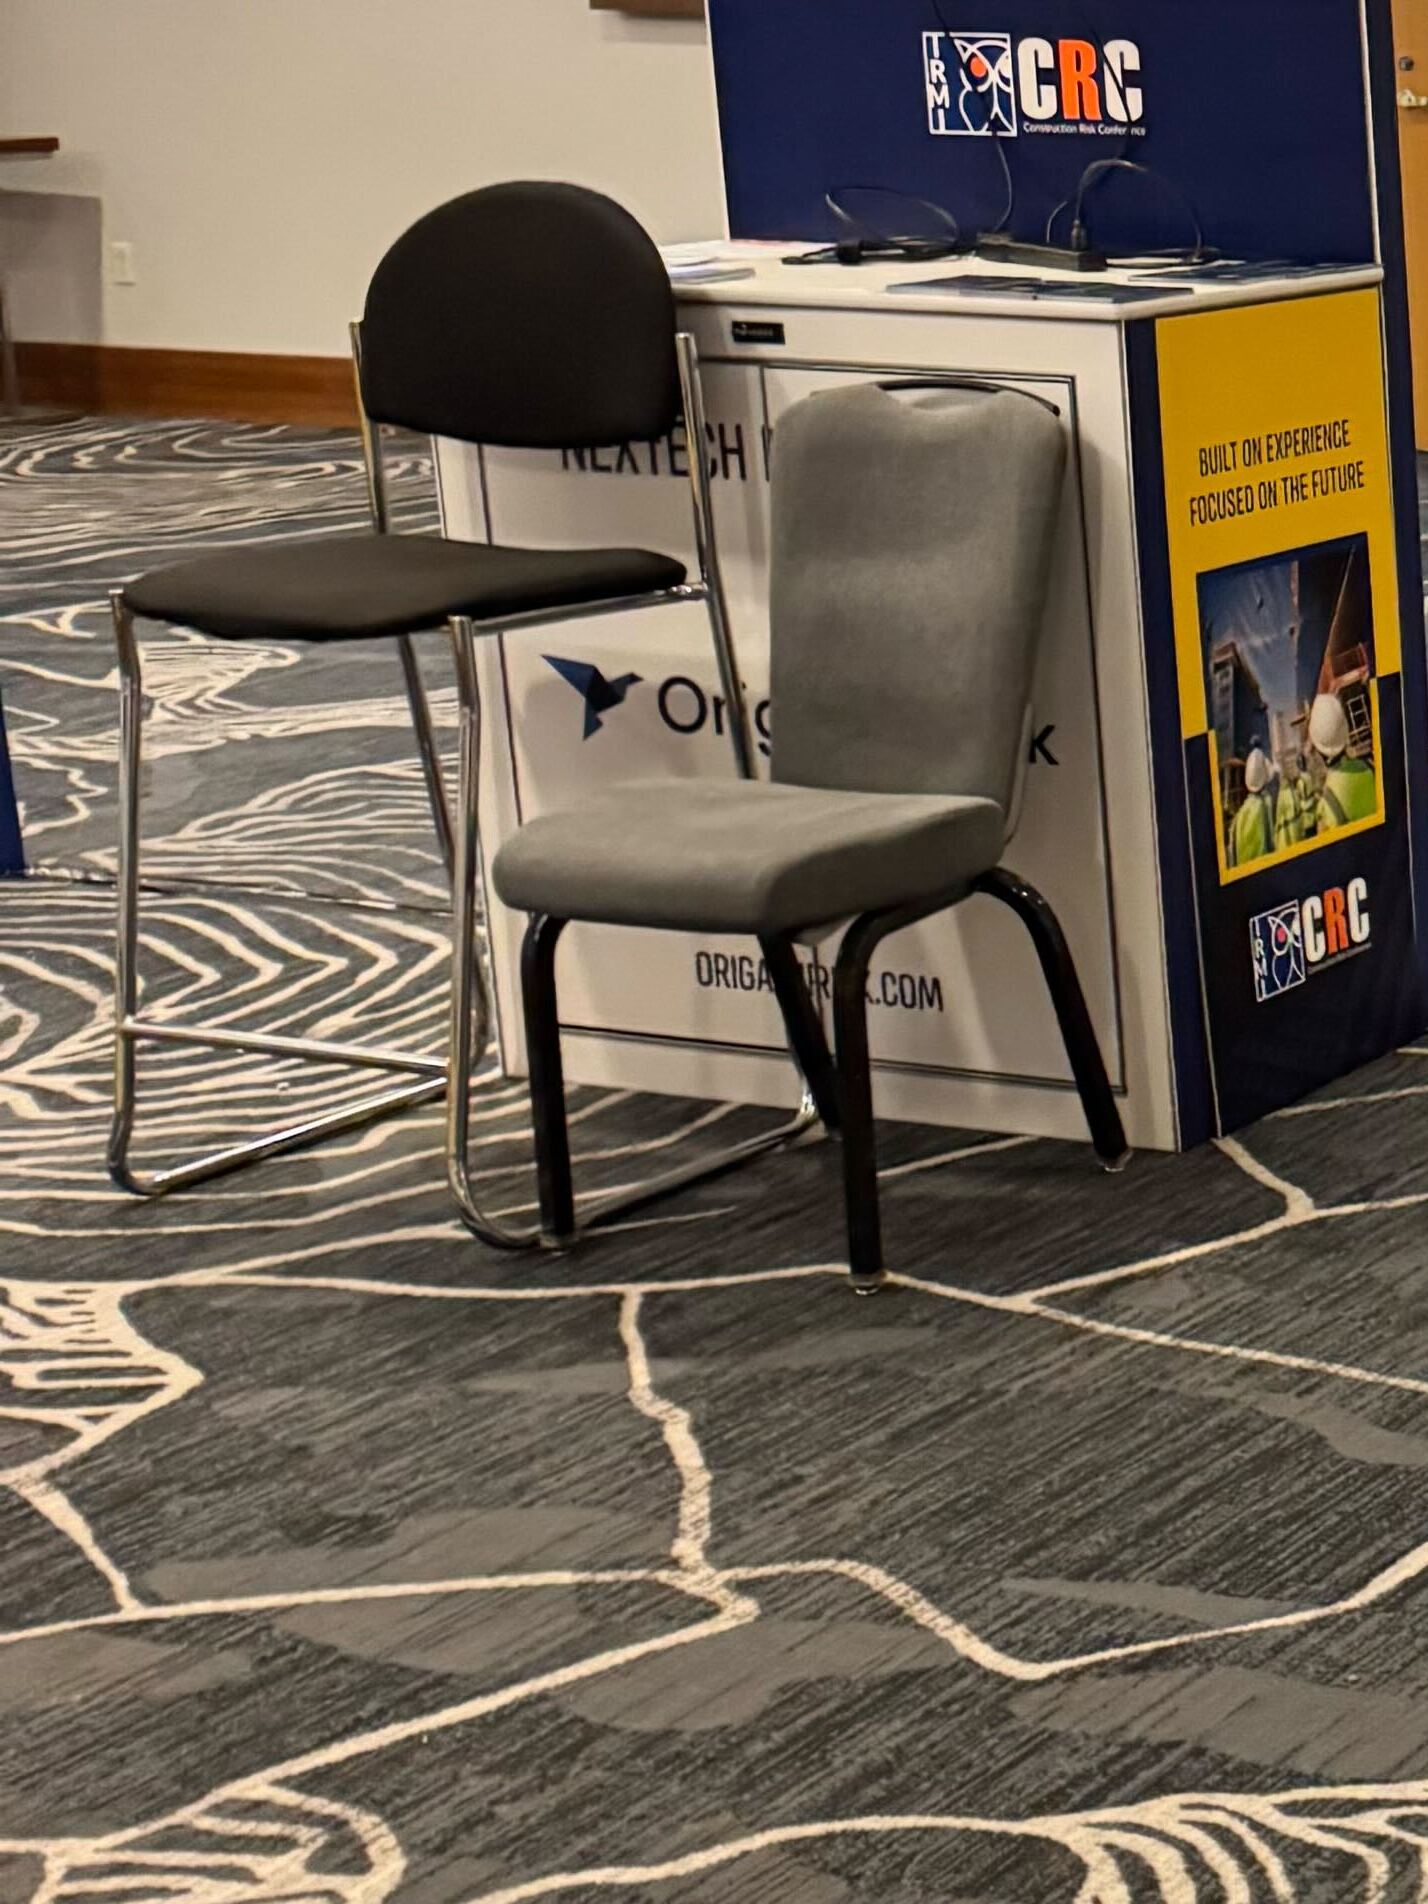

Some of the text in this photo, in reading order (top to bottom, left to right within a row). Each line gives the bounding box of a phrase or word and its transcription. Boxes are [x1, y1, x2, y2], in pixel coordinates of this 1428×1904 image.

[1018, 37, 1143, 123] CRC
[1098, 124, 1146, 136] Confernce
[1199, 419, 1351, 477] BUILT ON EXPERIENCE
[1190, 460, 1365, 527] FOCUSED ON THE FUTURE
[1302, 877, 1370, 963] CRC
